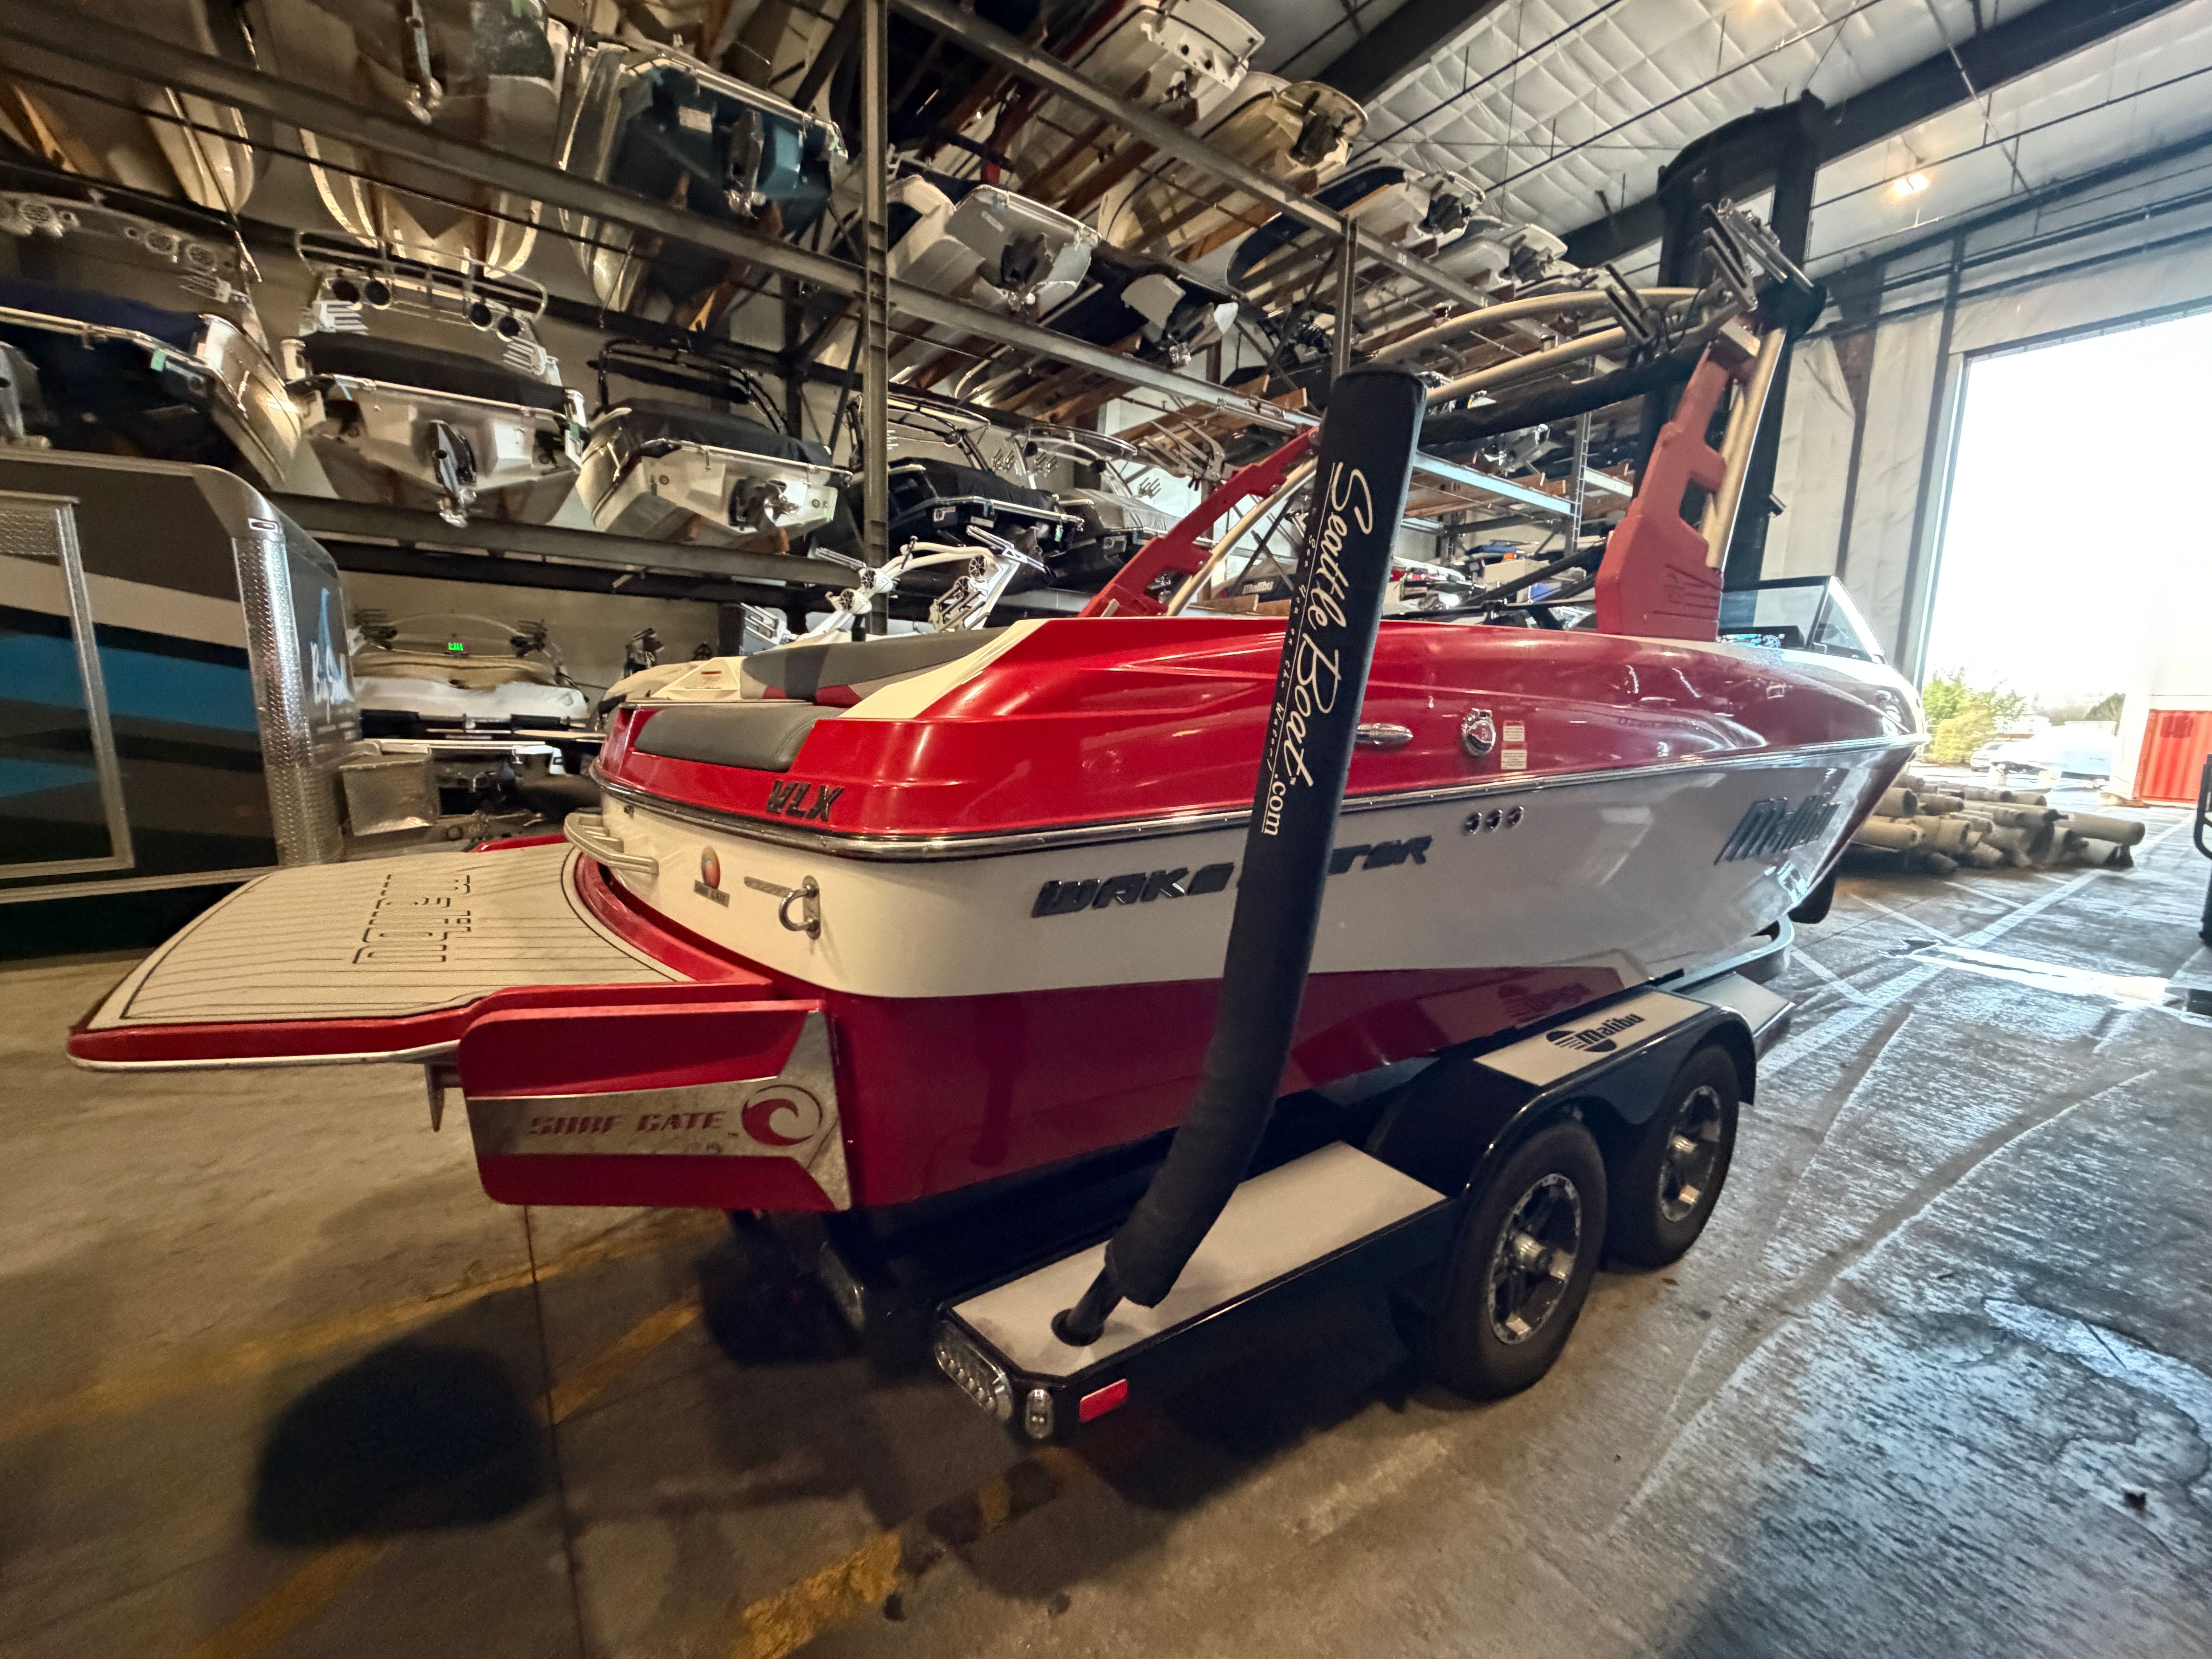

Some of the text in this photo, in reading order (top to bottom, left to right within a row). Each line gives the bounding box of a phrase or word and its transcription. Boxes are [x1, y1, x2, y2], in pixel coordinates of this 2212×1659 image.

[1304, 535, 1316, 568] See
[1307, 462, 1373, 630] Seattle
[1288, 628, 1295, 646] on
[1281, 660, 1290, 688] the
[766, 780, 845, 823] VLX
[1574, 1013, 1645, 1045] Malibu
[529, 1111, 726, 1135] SURF GATE
